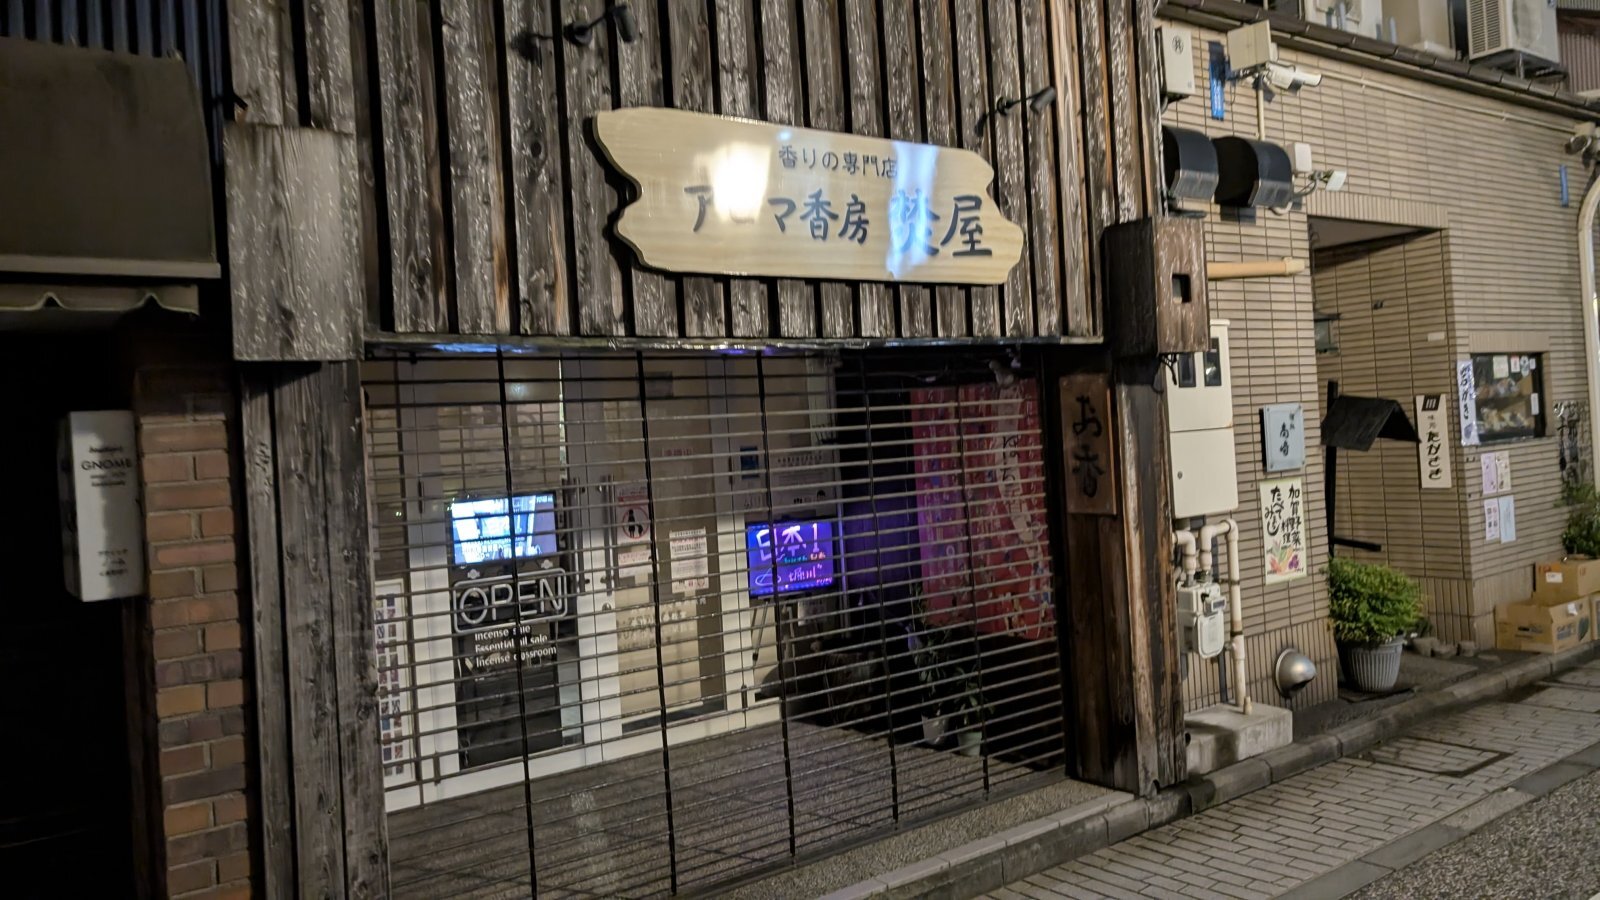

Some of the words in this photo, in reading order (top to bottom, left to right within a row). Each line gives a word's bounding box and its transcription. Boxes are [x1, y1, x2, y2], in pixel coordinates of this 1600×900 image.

[778, 144, 898, 178] 香りの専門店
[684, 185, 870, 245] アマ香房
[81, 458, 132, 471] GNOME
[460, 578, 562, 624] OPEN
[474, 629, 509, 641] Incense
[513, 625, 531, 636] sle
[474, 639, 515, 653] Essential
[530, 634, 548, 645] sale
[476, 653, 511, 668] Incense
[513, 646, 557, 661] cassroom
